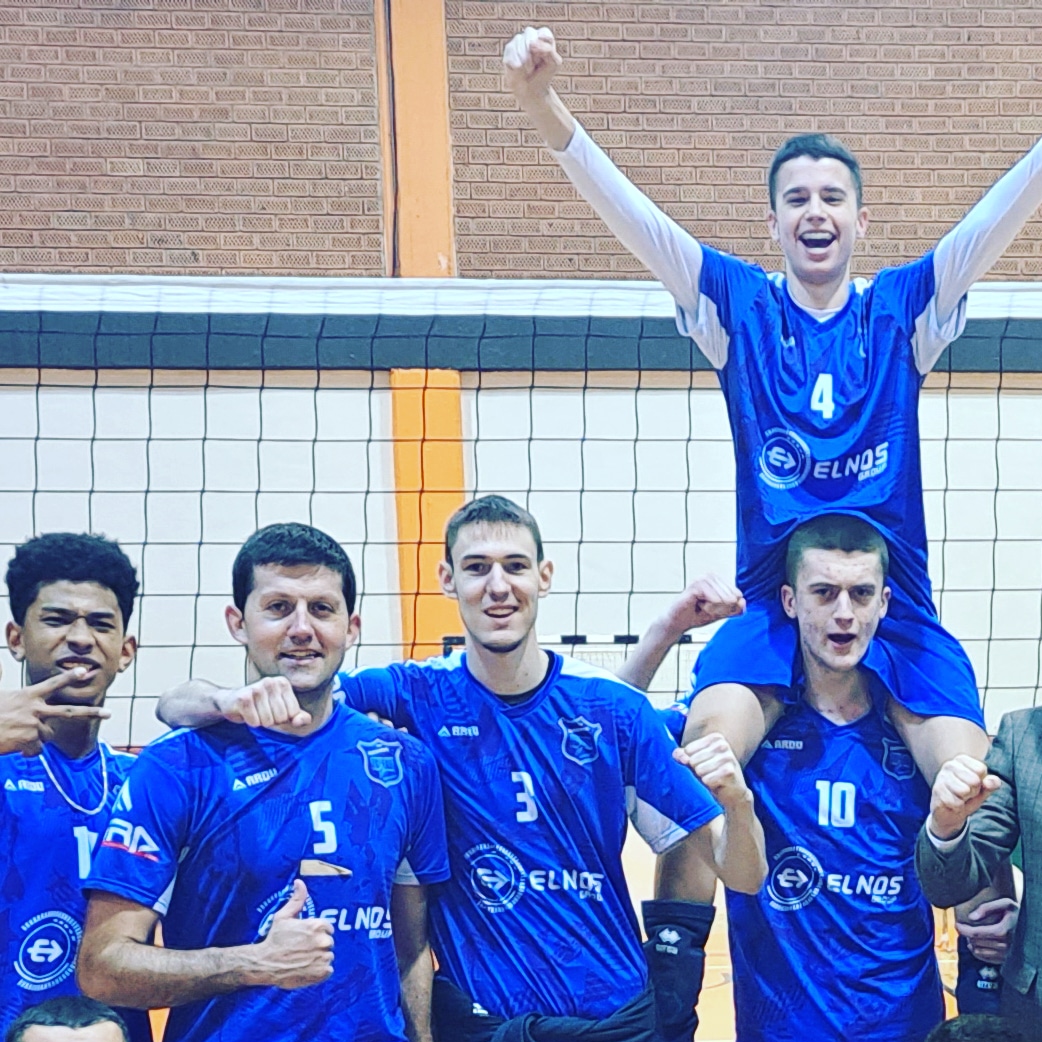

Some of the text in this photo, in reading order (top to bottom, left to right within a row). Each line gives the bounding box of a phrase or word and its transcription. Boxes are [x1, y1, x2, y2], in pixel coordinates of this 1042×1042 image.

[810, 373, 835, 419] 4
[813, 442, 889, 479] ELNOS
[857, 463, 888, 482] GROUP
[511, 771, 539, 823] 3
[815, 780, 857, 828] 10
[308, 800, 338, 855] 5
[528, 869, 605, 892] ELNOS
[827, 873, 904, 896] ELNOS
